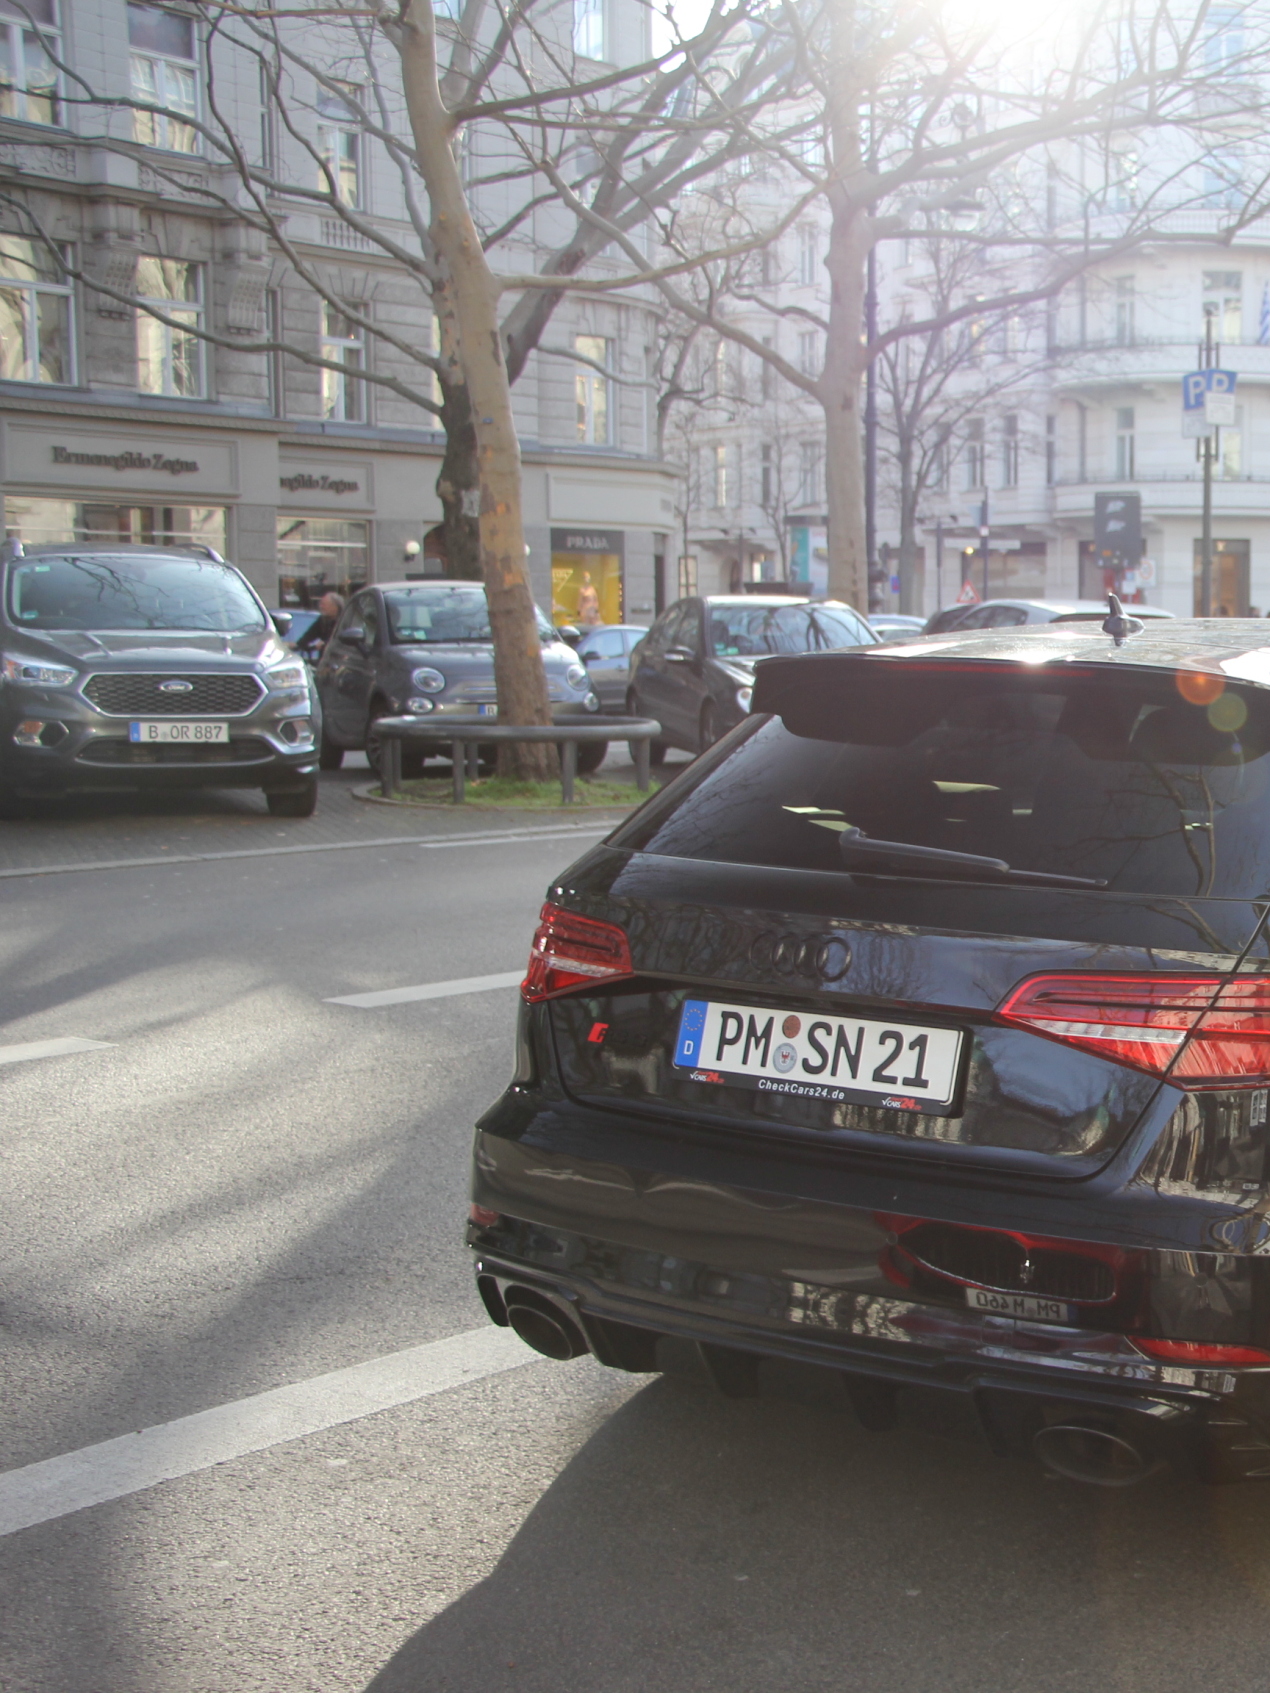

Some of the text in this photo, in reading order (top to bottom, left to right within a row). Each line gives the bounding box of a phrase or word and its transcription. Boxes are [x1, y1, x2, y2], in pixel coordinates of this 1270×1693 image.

[51, 446, 199, 476] Ermenegildo Zegna
[320, 474, 360, 495] Zegna
[566, 536, 610, 549] PRADA
[148, 725, 223, 740] B OR 887
[684, 1041, 693, 1055] D
[716, 1011, 774, 1068] PM
[802, 1022, 865, 1080] SN
[872, 1030, 930, 1090] 21
[758, 1079, 846, 1101] CheckCars24.de
